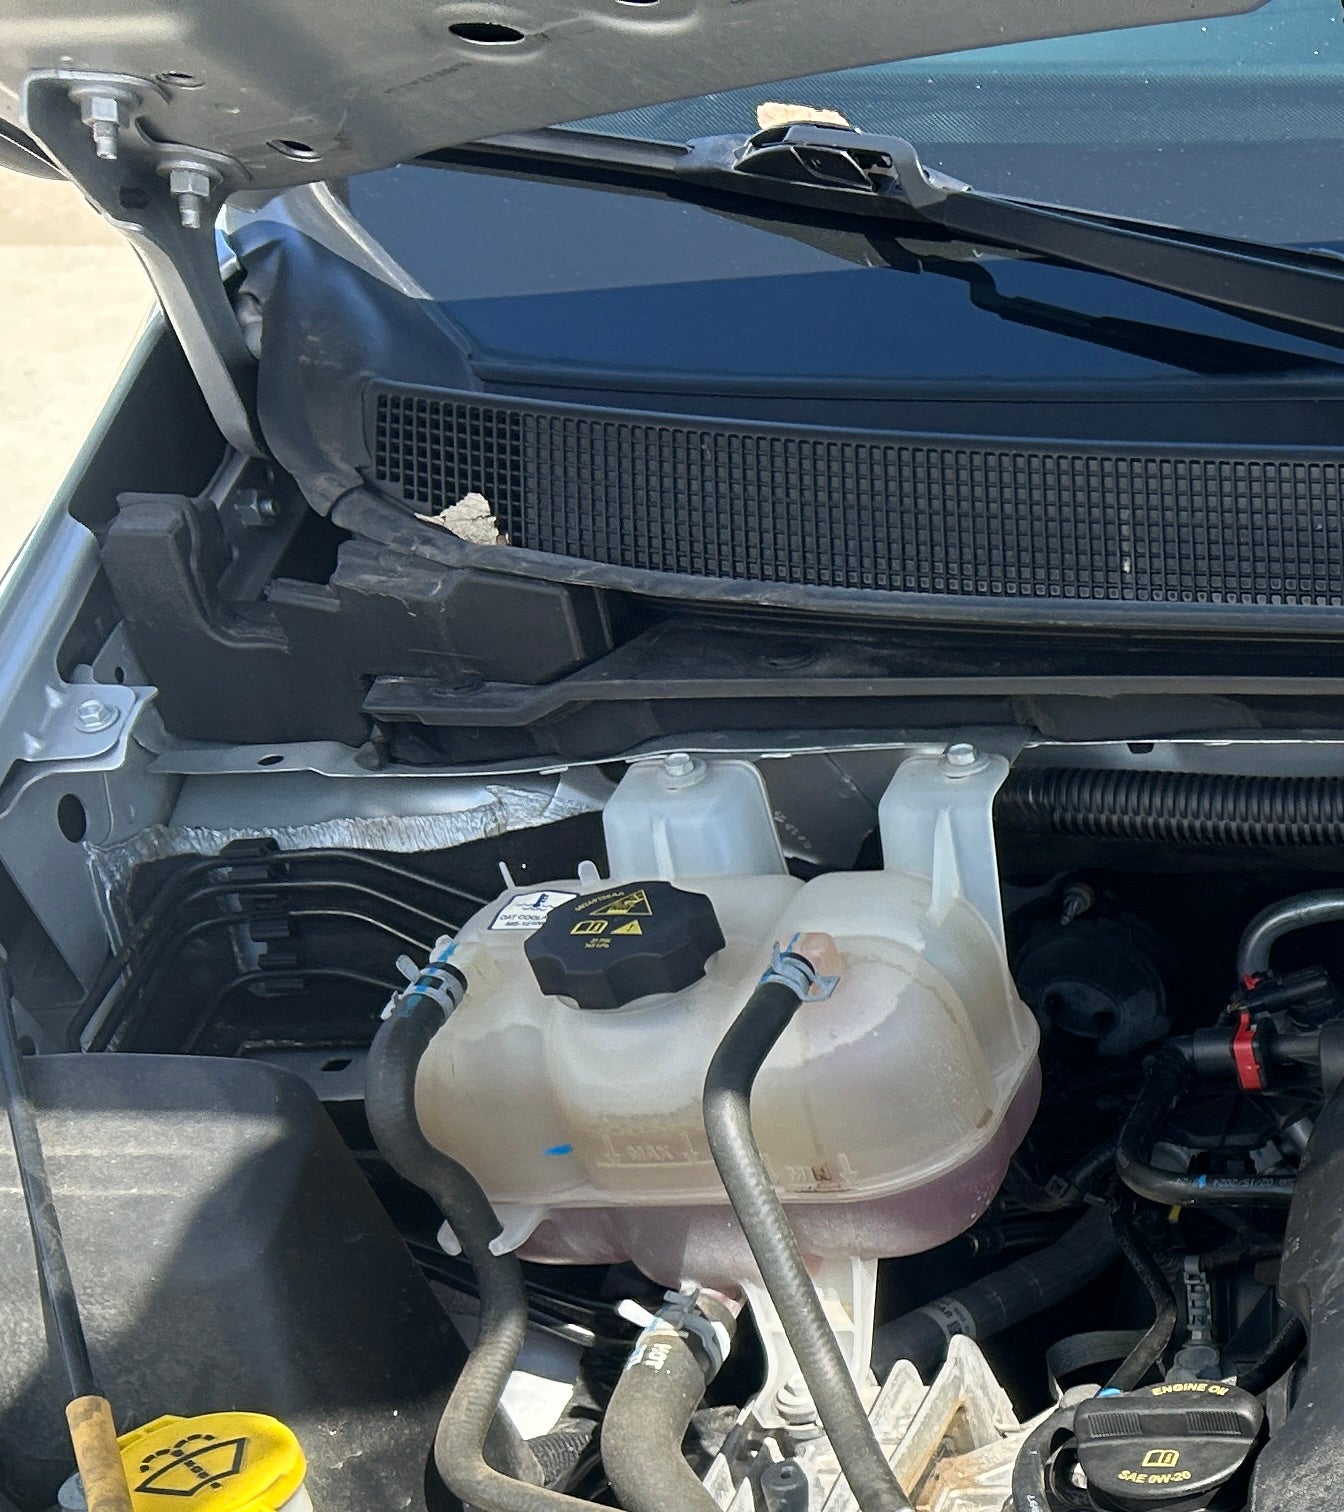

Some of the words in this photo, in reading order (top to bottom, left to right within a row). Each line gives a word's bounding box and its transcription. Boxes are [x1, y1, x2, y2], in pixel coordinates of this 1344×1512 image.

[1151, 1382, 1208, 1396] ENGINE
[1207, 1385, 1230, 1396] OIL
[1118, 1469, 1148, 1484] SAE
[1148, 1470, 1192, 1484] 0W-20
